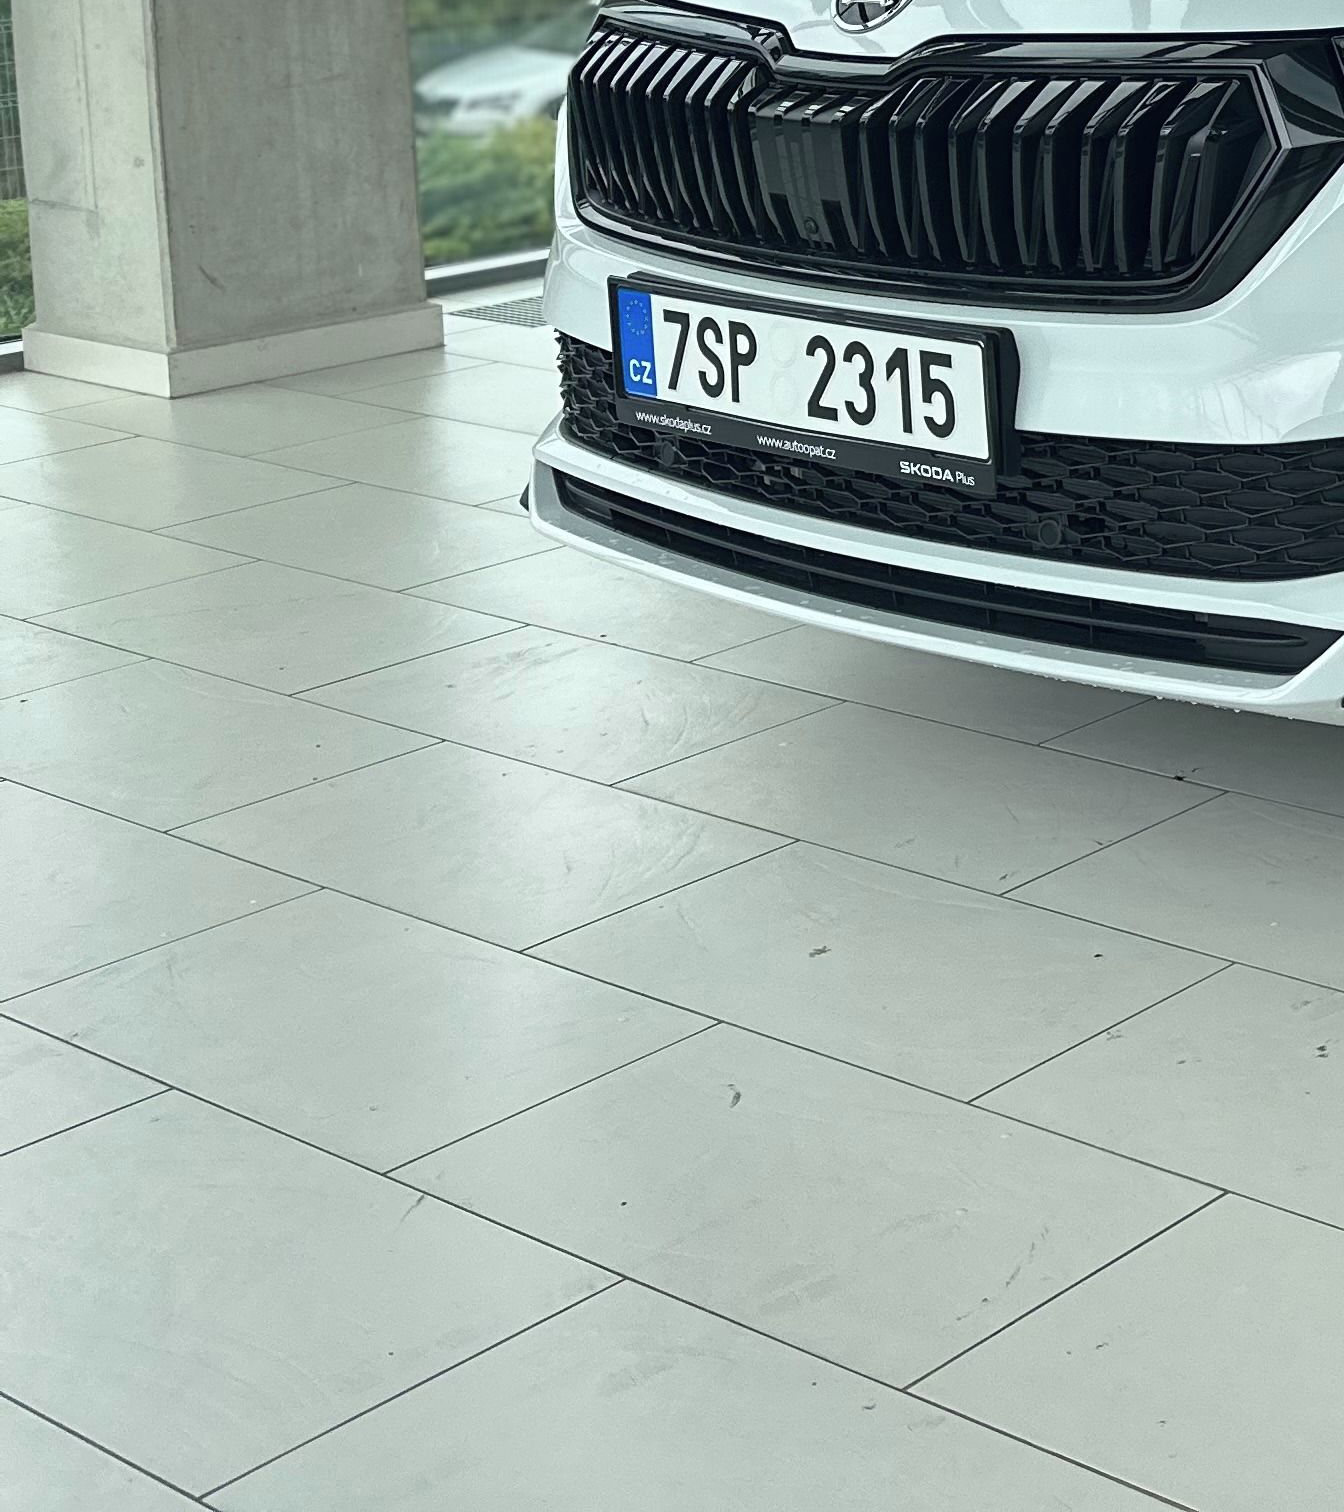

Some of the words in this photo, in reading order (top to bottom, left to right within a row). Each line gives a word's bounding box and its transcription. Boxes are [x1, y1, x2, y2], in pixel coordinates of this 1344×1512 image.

[629, 357, 653, 385] CZ
[663, 308, 758, 403] 7SP
[805, 335, 956, 439] 2315
[635, 410, 712, 436] www.skodaplus.cz
[756, 434, 837, 460] www.autoopat.cz
[955, 470, 975, 487] Plus
